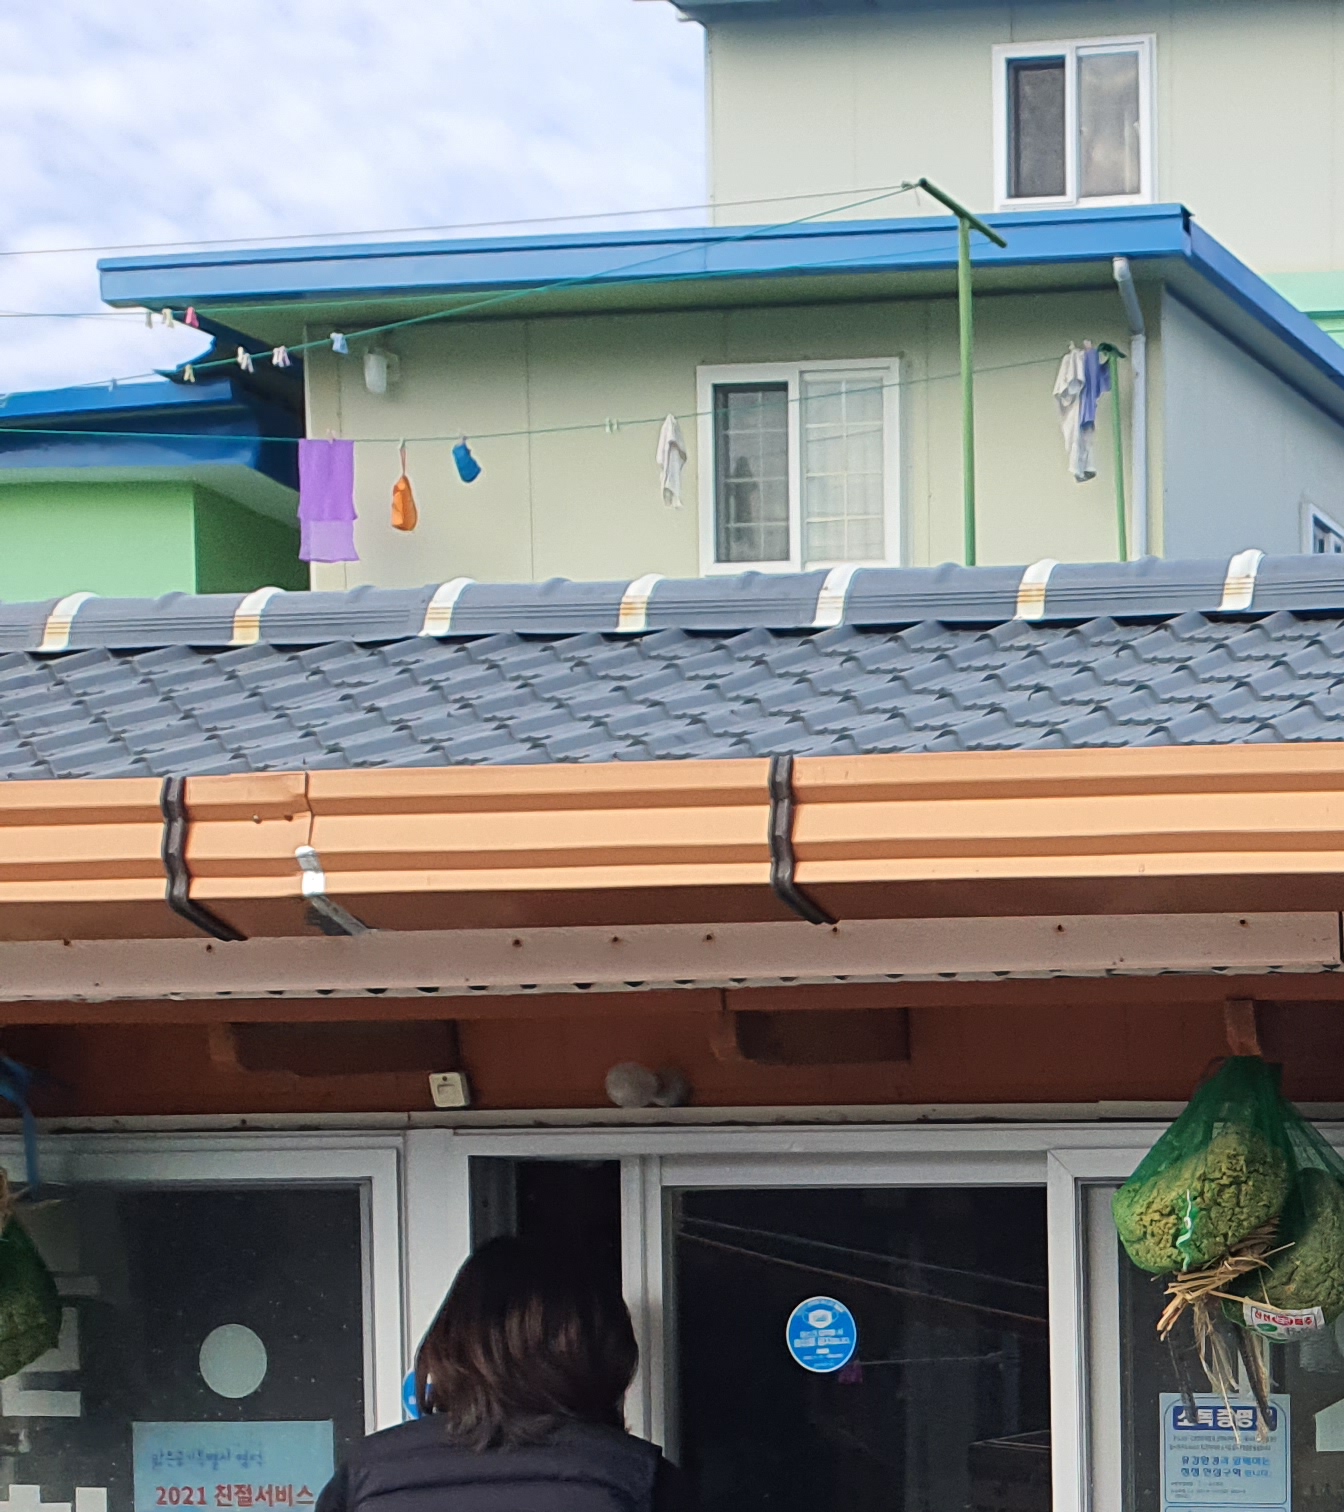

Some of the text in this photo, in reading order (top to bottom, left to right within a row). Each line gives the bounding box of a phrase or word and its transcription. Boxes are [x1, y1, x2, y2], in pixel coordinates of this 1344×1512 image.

[1177, 1408, 1274, 1428] 소독증명
[155, 1484, 315, 1507] 2021 친절서비스
